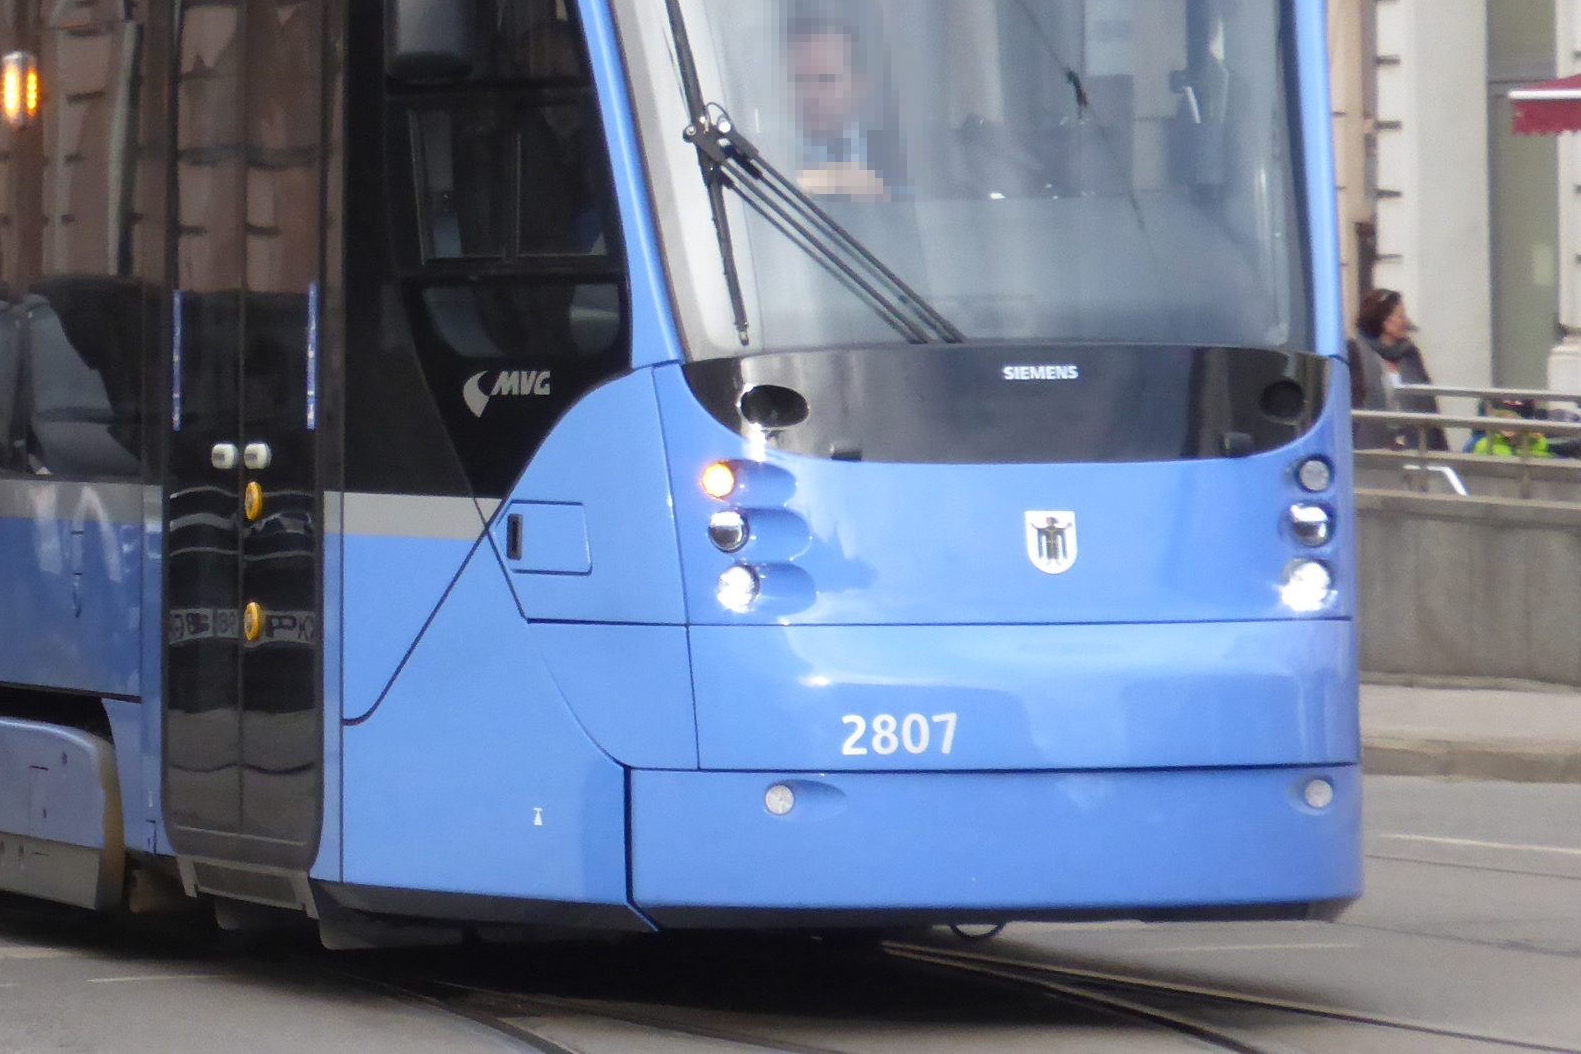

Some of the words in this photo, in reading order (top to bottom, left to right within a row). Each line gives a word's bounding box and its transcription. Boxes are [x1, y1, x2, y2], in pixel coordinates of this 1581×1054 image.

[489, 370, 551, 396] MVG
[1003, 365, 1079, 380] SIEMENS
[841, 712, 958, 755] 2807
